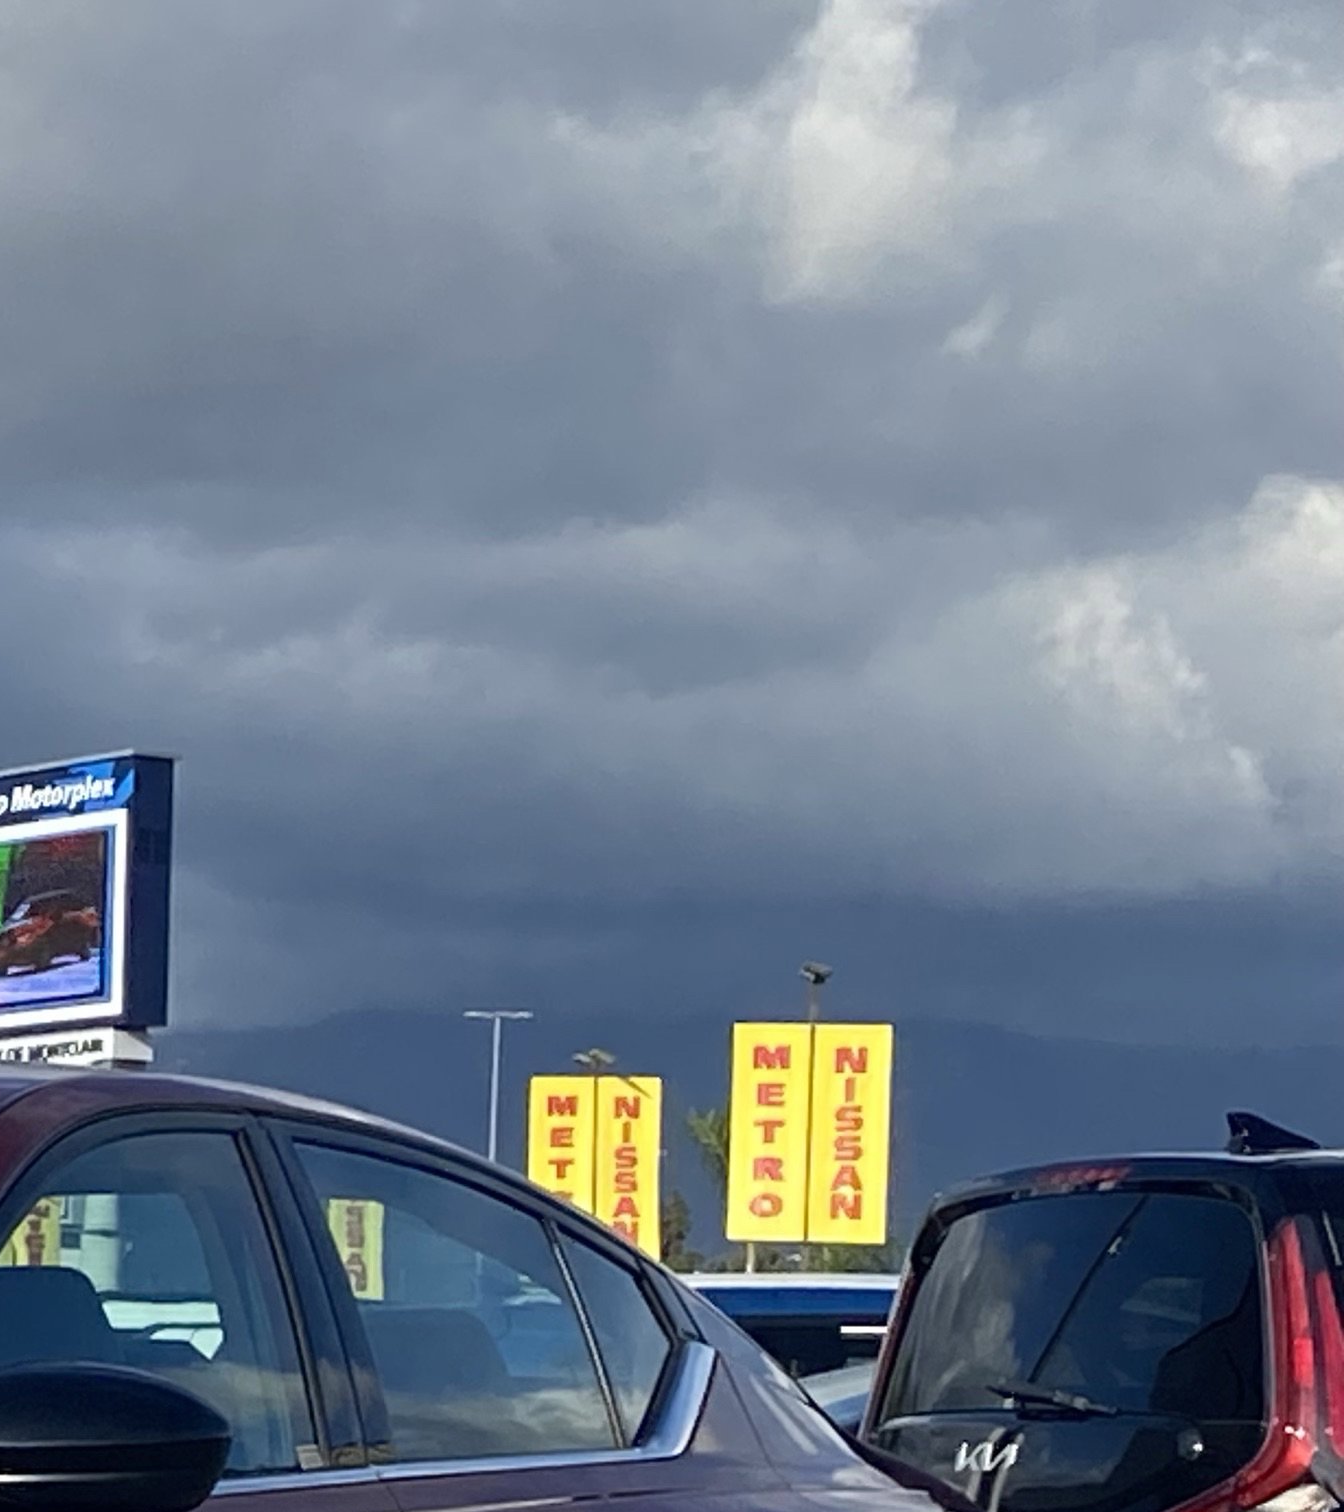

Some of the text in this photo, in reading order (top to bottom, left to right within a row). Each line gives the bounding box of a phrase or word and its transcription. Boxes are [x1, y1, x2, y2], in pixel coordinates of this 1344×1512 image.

[10, 774, 115, 813] Motorplex
[547, 1095, 579, 1202] MET
[749, 1044, 792, 1218] METRO
[830, 1046, 869, 1220] NISSAN
